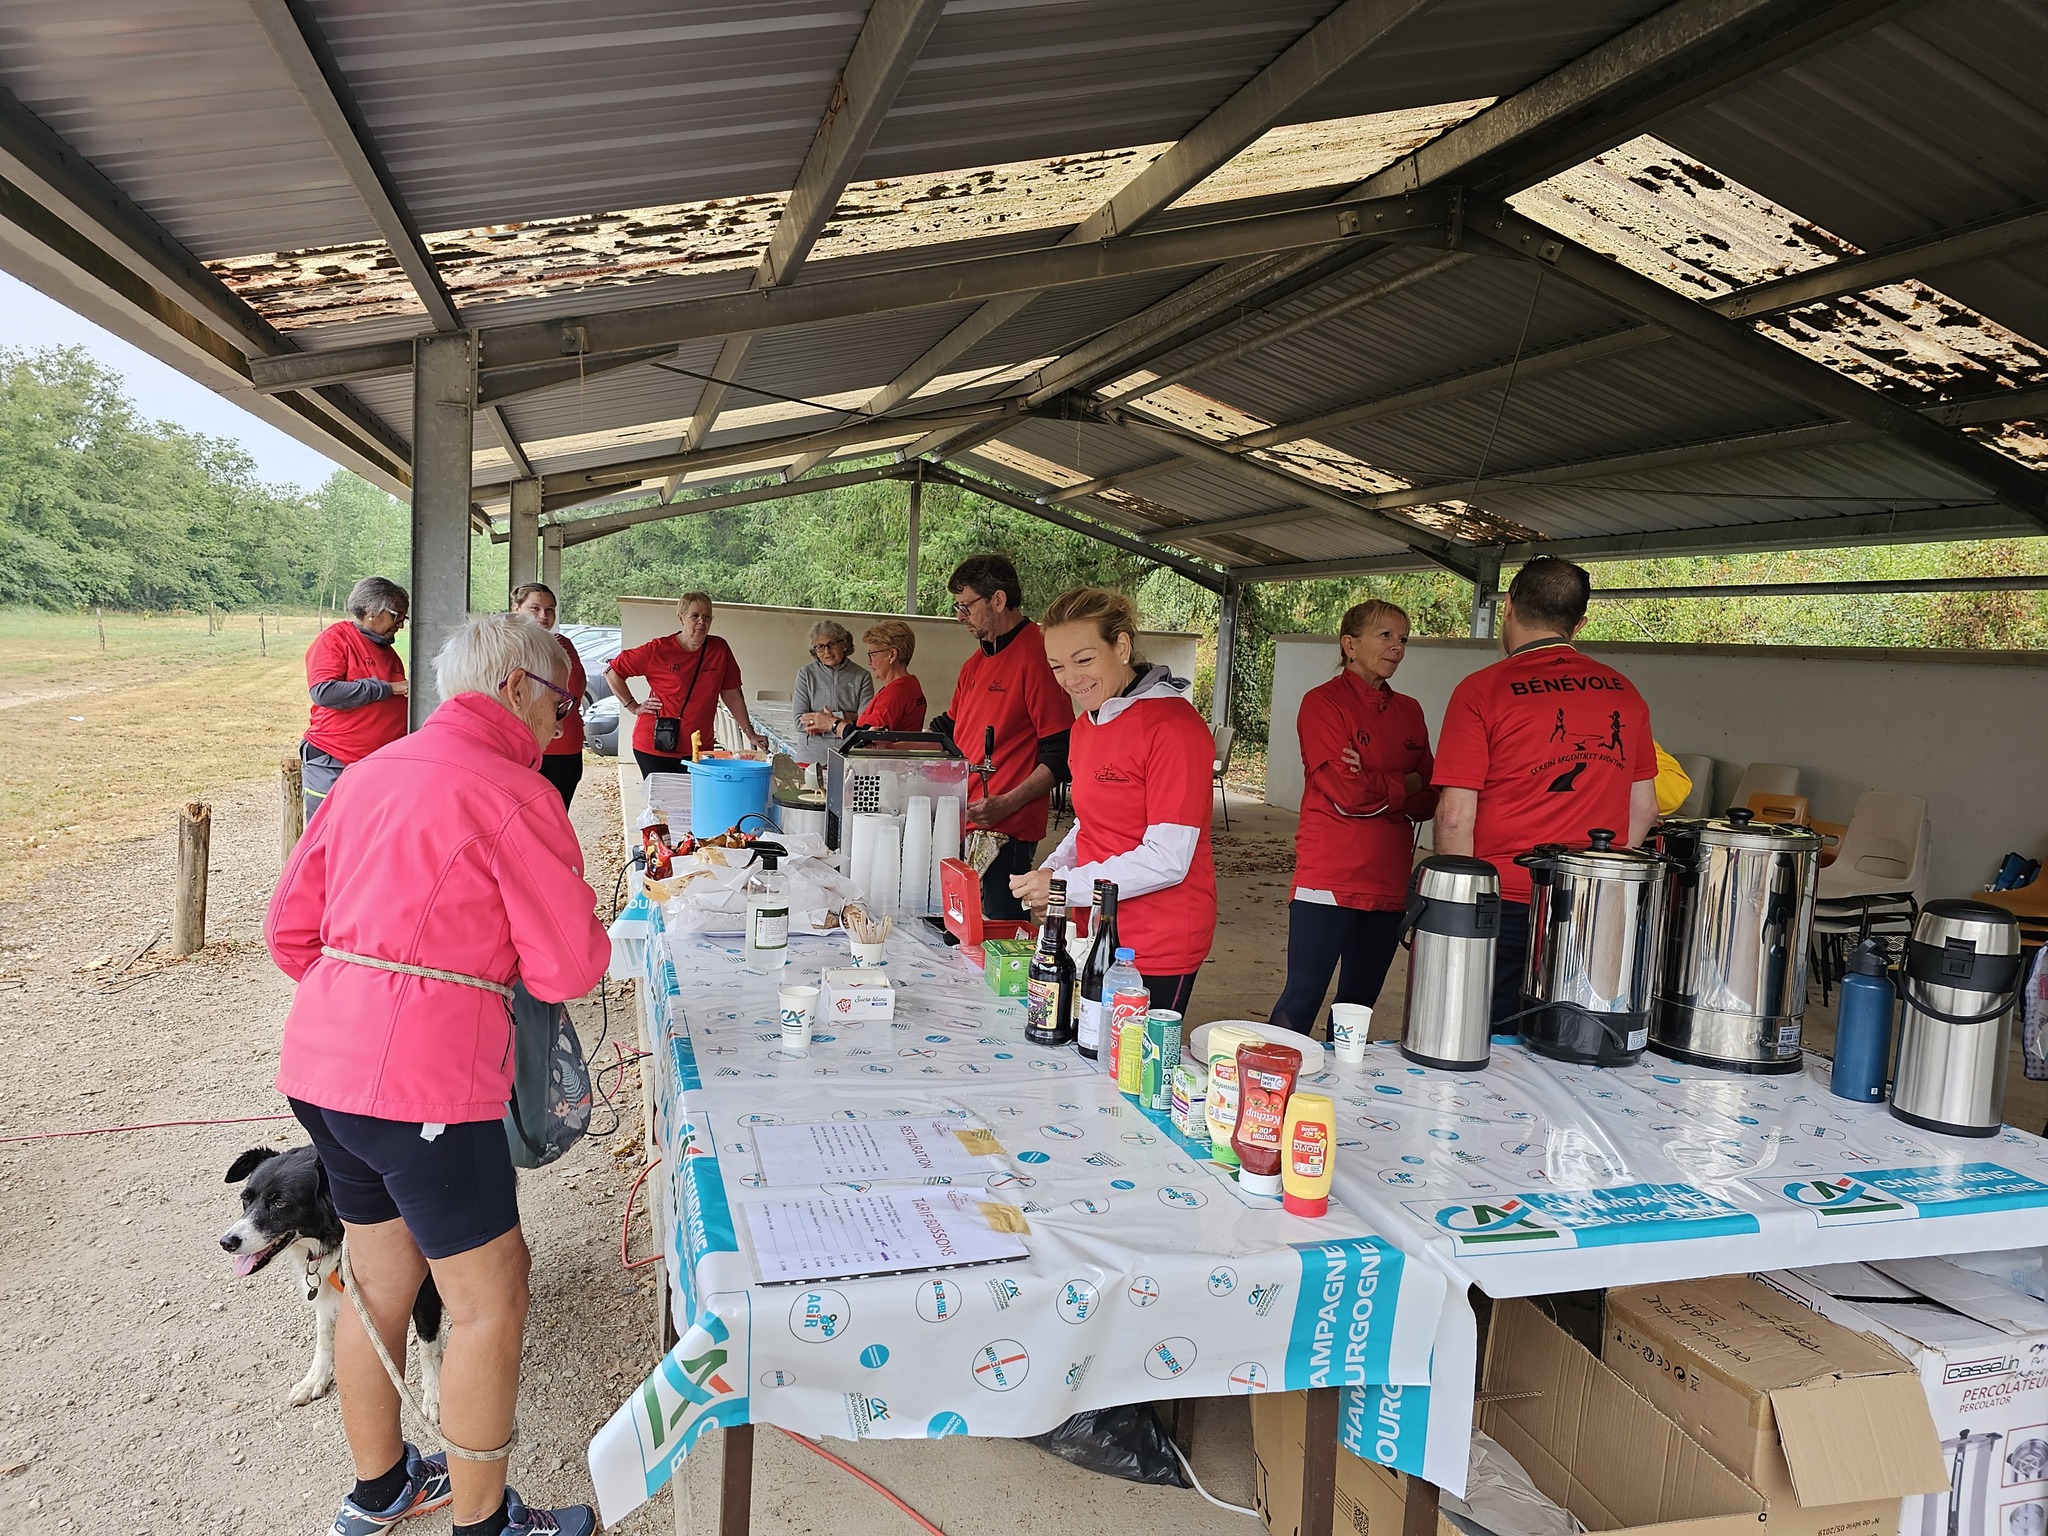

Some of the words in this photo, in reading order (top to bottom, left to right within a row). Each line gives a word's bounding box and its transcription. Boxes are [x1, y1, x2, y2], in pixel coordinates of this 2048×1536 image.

[1510, 674, 1624, 696] BÉNÉVOLE
[1530, 758, 1556, 777] SEREIN
[1599, 754, 1626, 771] AVENTURE
[837, 1001, 851, 1011] TOP
[1246, 1107, 1281, 1125] Ketchup
[899, 1125, 934, 1169] RESTAURATION
[1252, 1132, 1276, 1141] BOUTON
[1293, 1143, 1320, 1153] DIJON
[1873, 1171, 2017, 1189] CHAMPAGNE
[1544, 1192, 1710, 1214] CHAMPAGNE
[1783, 1180, 1887, 1206] CA
[1901, 1183, 2041, 1202] BOURGOGNE
[1435, 1202, 1546, 1233] CA
[1568, 1205, 1732, 1226] BOURGOGNE
[912, 1197, 932, 1220] TARIF
[923, 1218, 956, 1257] BOISSONS
[933, 1280, 948, 1320] ENSEMBLE
[984, 1346, 1008, 1387] AUTREMENT
[1155, 1343, 1183, 1375] ENSEMBLE
[849, 1392, 863, 1436] BOURGOGNE
[855, 1392, 870, 1435] CHAMPAGNE
[1959, 1396, 2012, 1414] PERCOLATOR
[1818, 1524, 1845, 1536] 05/2019
[1846, 1521, 1861, 1530] série
[1871, 1517, 1880, 1525] N°
